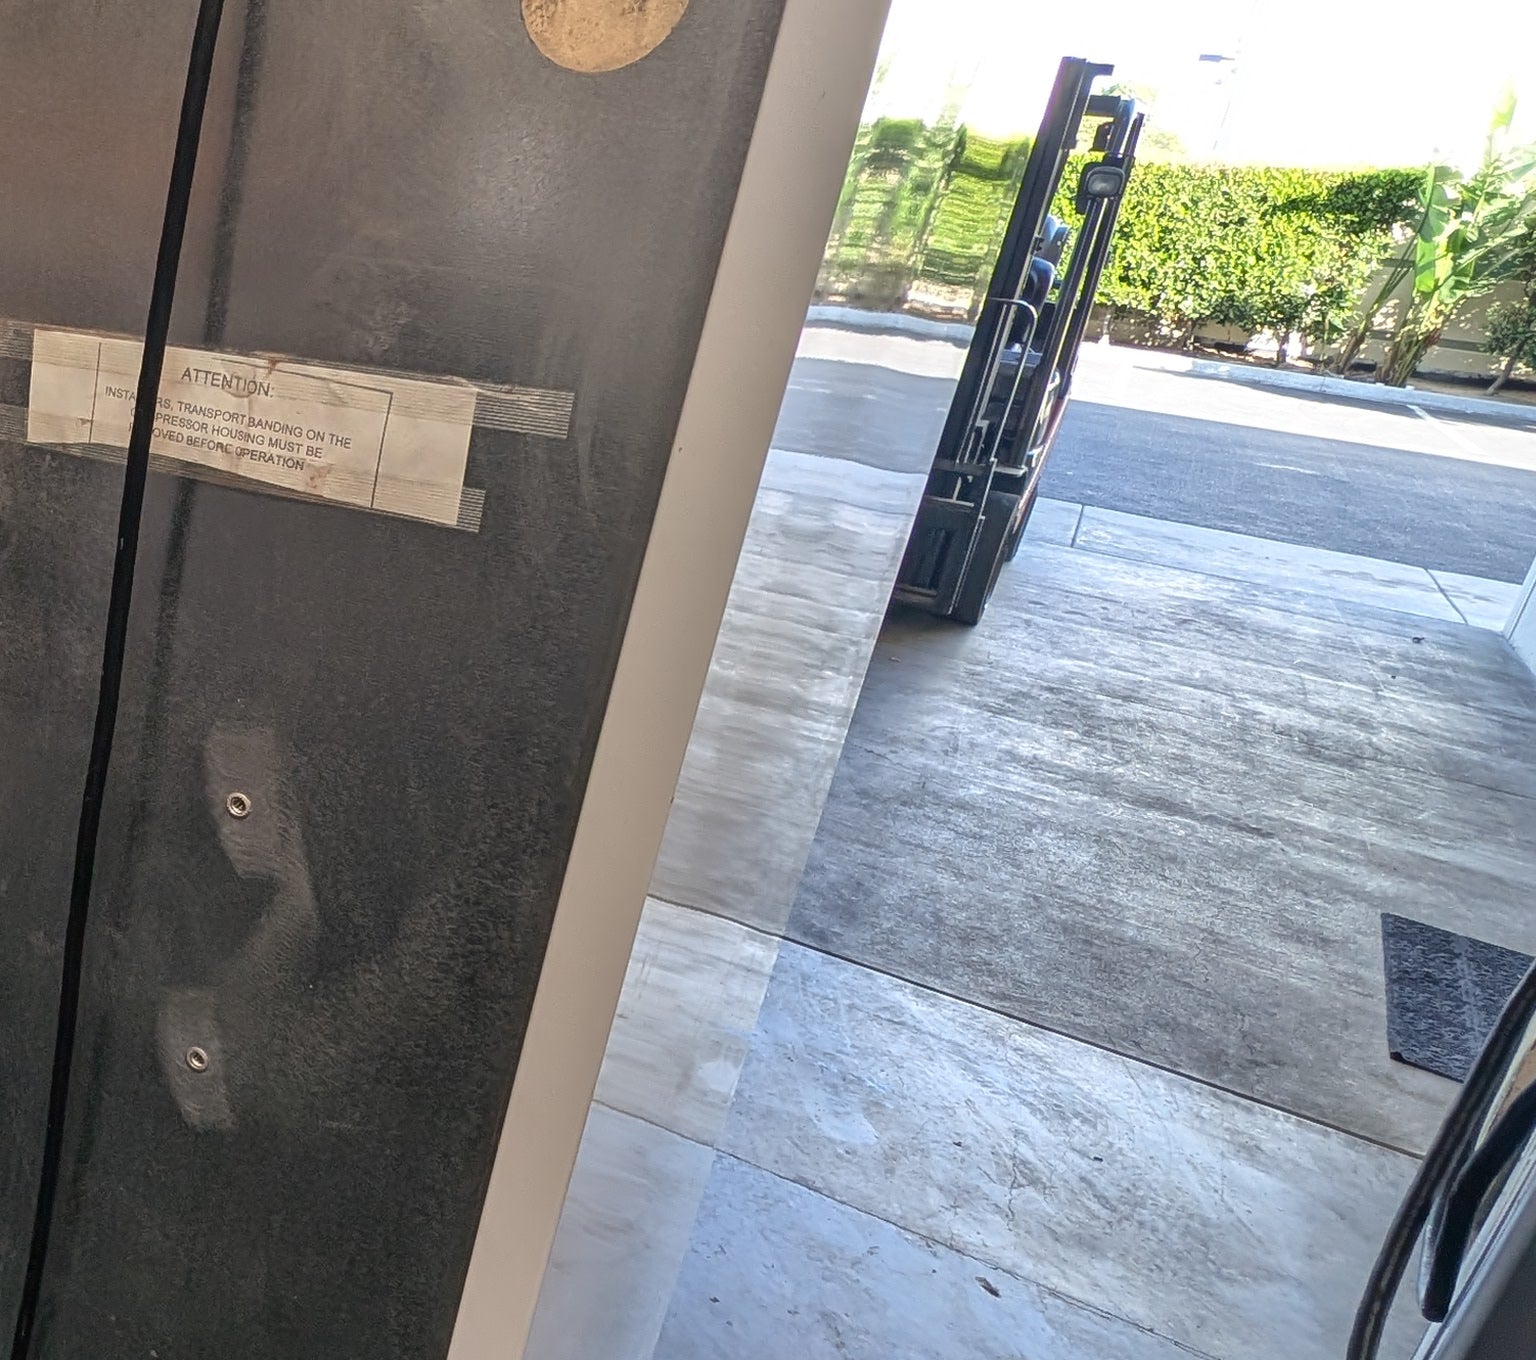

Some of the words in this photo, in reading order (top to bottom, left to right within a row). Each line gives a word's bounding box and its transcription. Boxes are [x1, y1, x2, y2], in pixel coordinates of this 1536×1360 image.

[181, 367, 275, 398] ATTENTION:
[105, 385, 174, 411] INSTARS,
[177, 401, 247, 425] TRANSPORT
[247, 416, 303, 438] BANDING
[306, 429, 325, 442] ON
[329, 433, 352, 449] THE
[186, 435, 233, 454] BEFORE
[235, 445, 305, 470] OPERATION
[211, 424, 265, 445] HOUSING
[268, 436, 303, 454] MUST
[305, 445, 323, 459] BE
